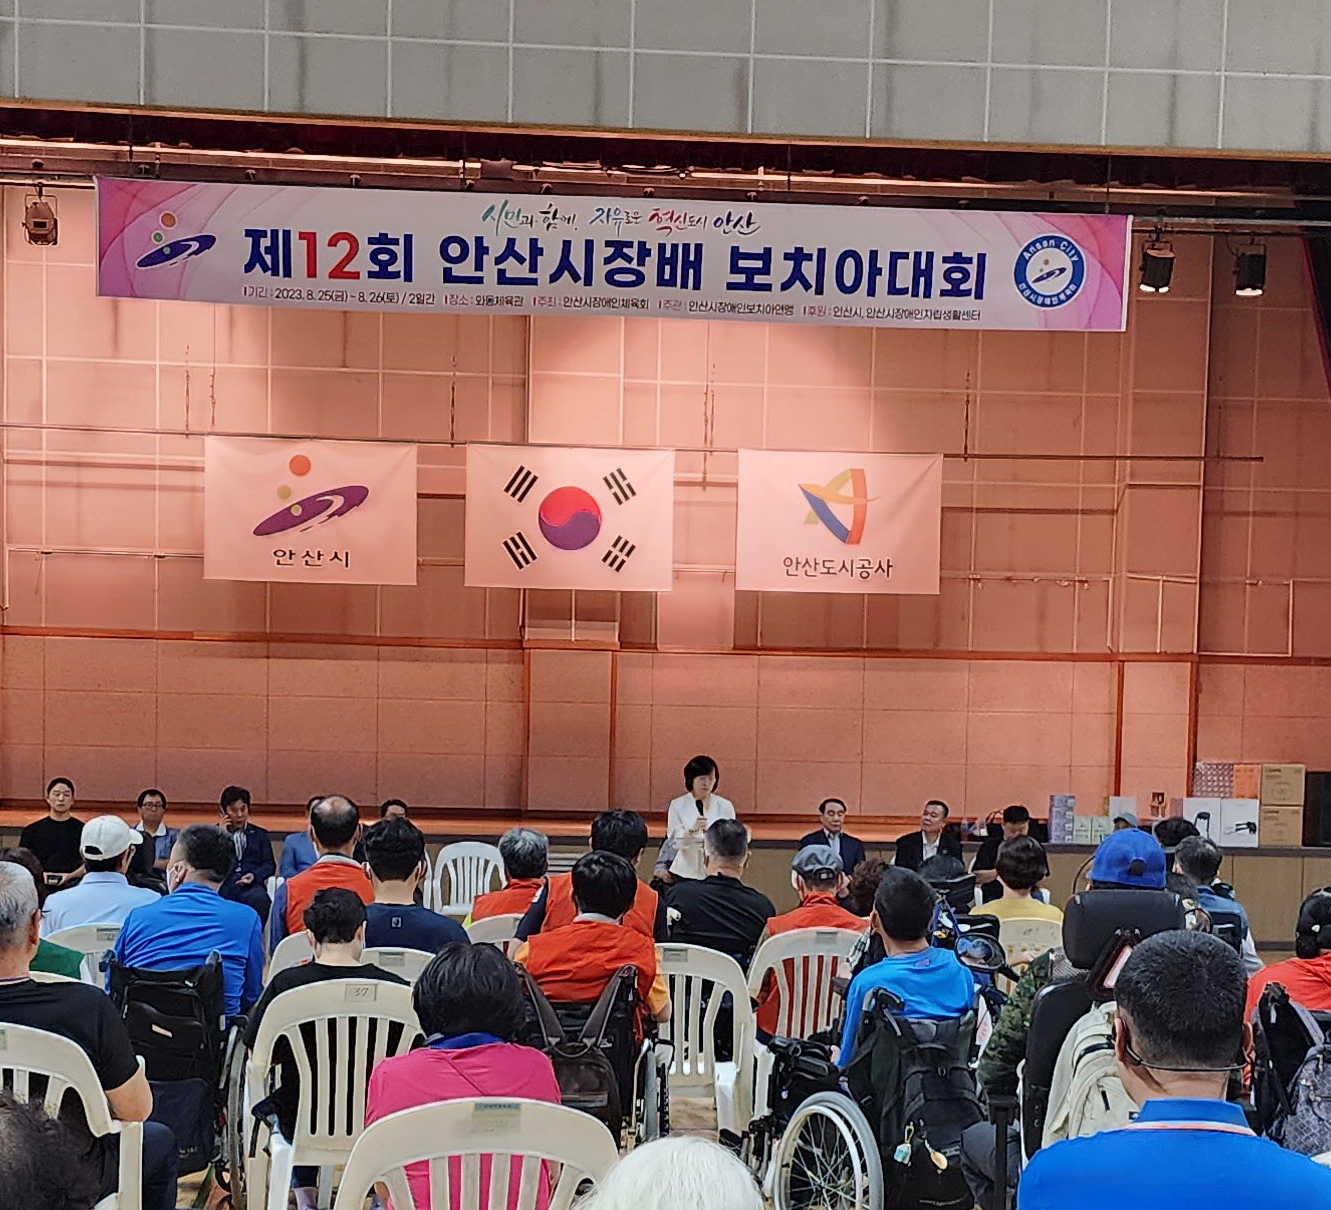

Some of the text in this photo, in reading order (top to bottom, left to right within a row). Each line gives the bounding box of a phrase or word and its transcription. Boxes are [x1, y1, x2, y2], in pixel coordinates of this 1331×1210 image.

[648, 208, 707, 236] 혁신도시
[713, 211, 760, 235] 안산
[1023, 240, 1055, 260] Ansan
[244, 229, 987, 300] 제12회 안산시장배 보치아대회
[273, 549, 349, 568] 안산시
[783, 557, 893, 579] 안산도시공사
